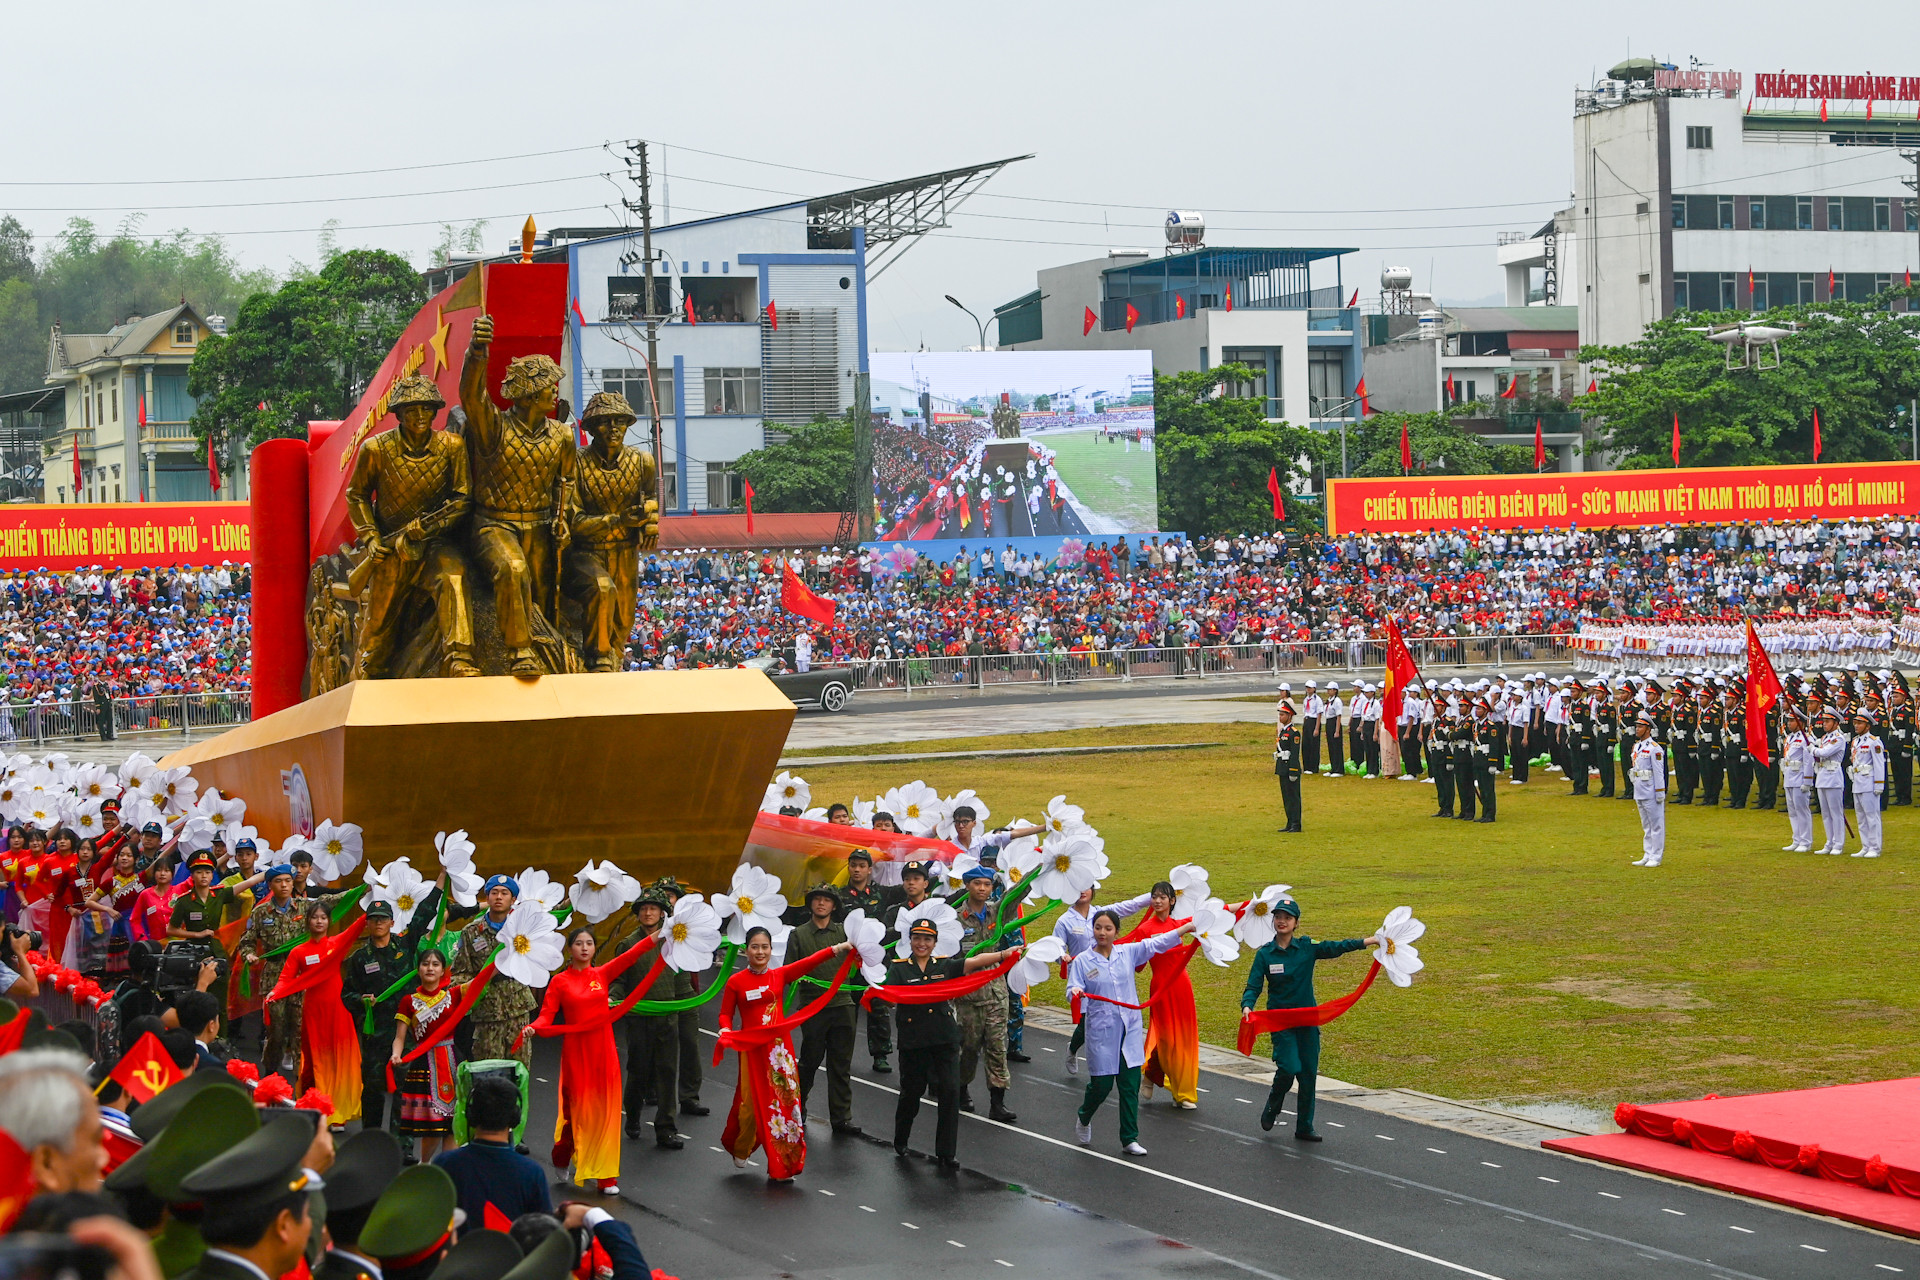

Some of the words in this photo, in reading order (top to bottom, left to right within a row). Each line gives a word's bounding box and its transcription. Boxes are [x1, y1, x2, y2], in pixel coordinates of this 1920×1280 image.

[1710, 71, 1742, 90] ANH
[1755, 69, 1807, 98] KHÁCH
[1845, 71, 1896, 100] HOÀNG
[1363, 490, 1407, 521] CHIẾN
[1410, 488, 1458, 520] THẮNG
[1461, 491, 1496, 524] ĐIỆN
[1500, 490, 1534, 518] BIÊN
[1538, 486, 1568, 516] PHỦ
[1581, 486, 1612, 515] SỨC
[1615, 489, 1660, 518] MẠNH
[1663, 484, 1693, 516] VIỆT
[1699, 487, 1733, 510] NAM
[1737, 480, 1770, 509] THỜI
[1774, 485, 1800, 513] ĐẠI
[1804, 476, 1824, 507] HỒ
[1828, 478, 1854, 507] CHÍ
[41, 518, 88, 556] THẮNG
[92, 522, 126, 561] ĐIỆN
[130, 521, 165, 554] BIÊN
[168, 516, 198, 553] PHỦ
[212, 519, 250, 551] LỪNG
